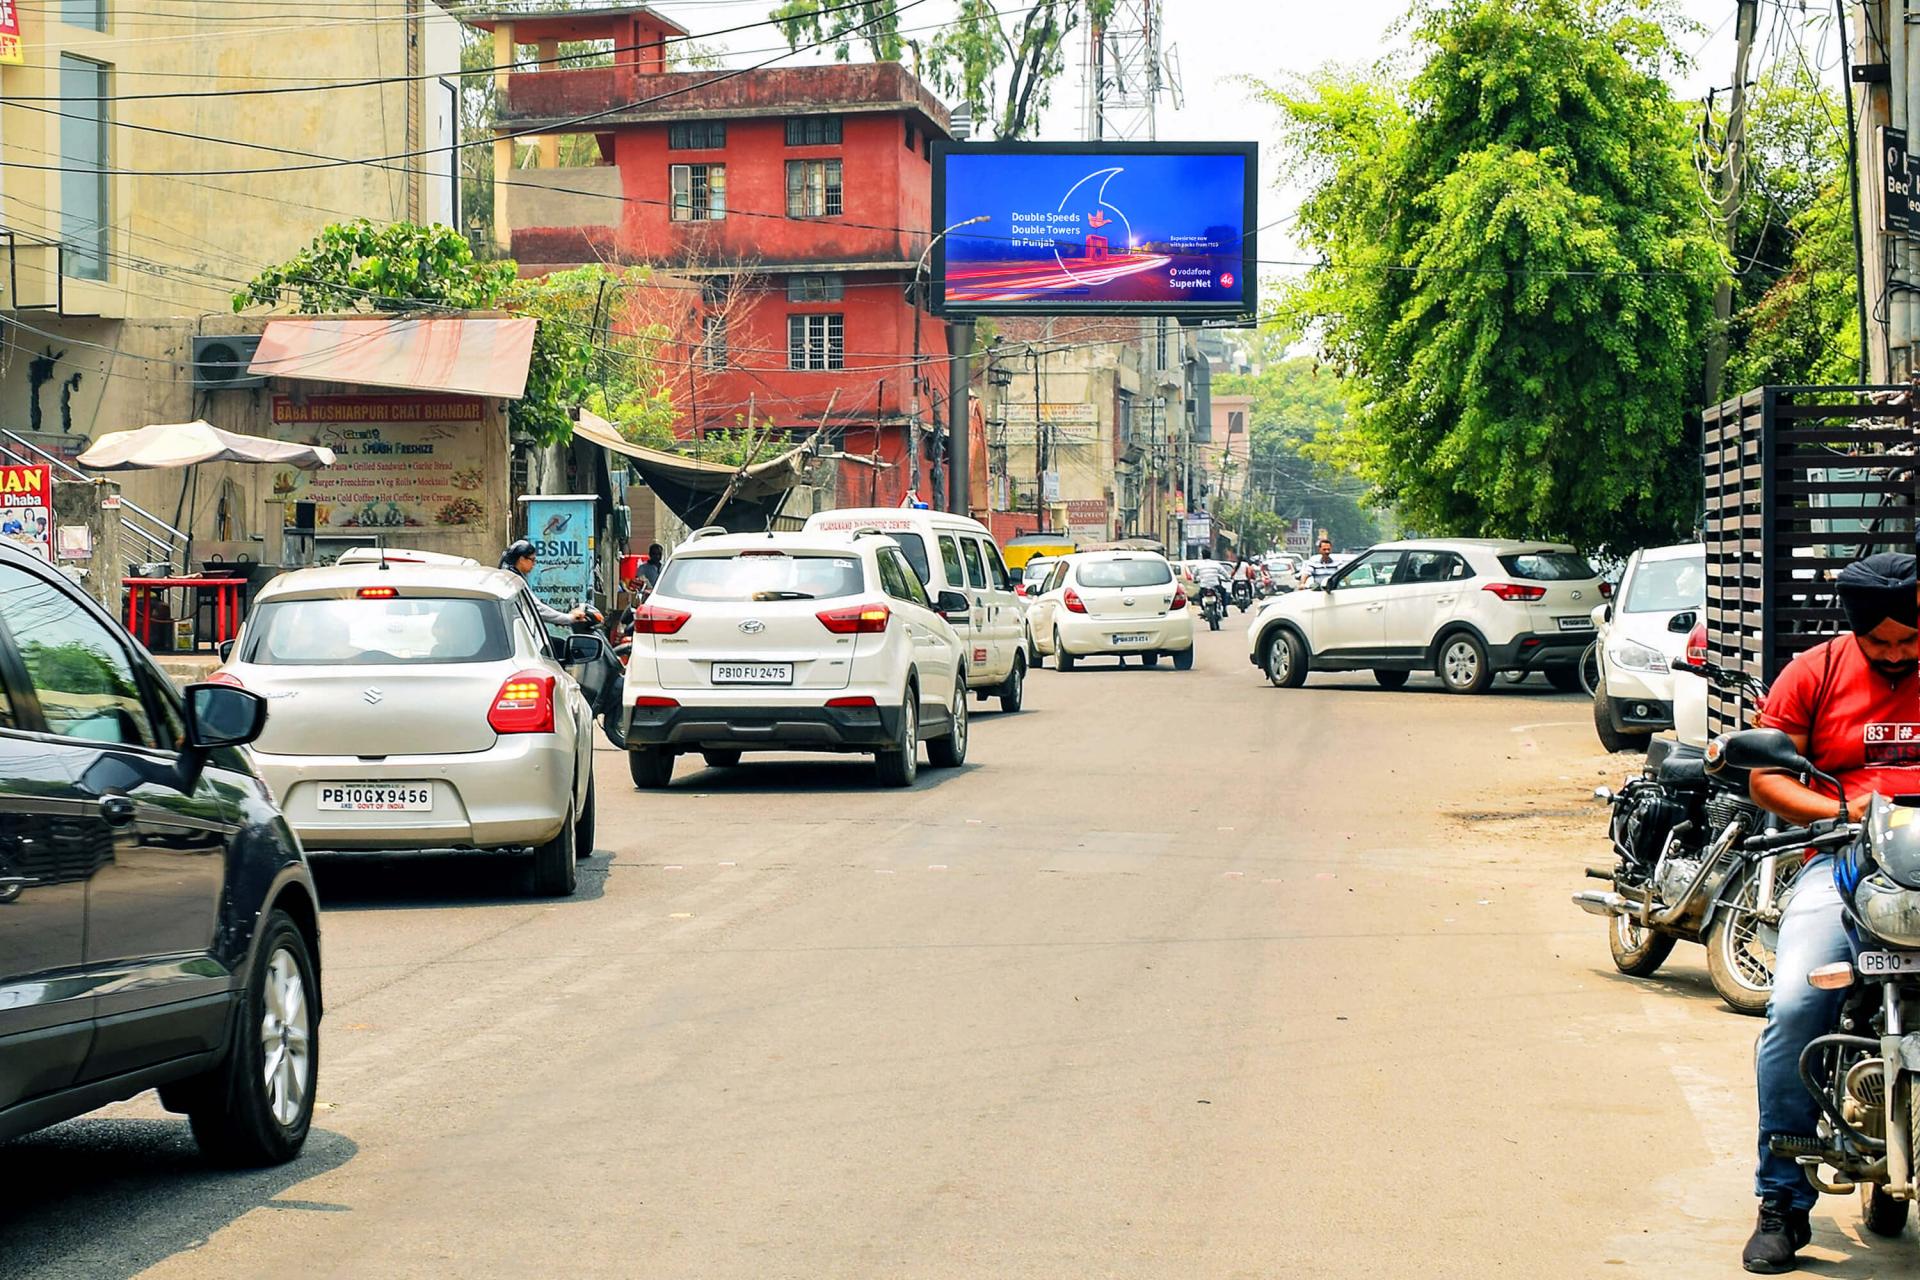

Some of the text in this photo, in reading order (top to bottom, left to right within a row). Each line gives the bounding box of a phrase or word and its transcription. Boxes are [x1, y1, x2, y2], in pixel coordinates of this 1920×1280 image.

[1012, 212, 1081, 224] Double Speeds
[1012, 225, 1081, 235] Double Towers
[1012, 237, 1055, 249] in Punjab
[1177, 267, 1212, 276] vodafone
[1169, 275, 1233, 290] SuperNet 4G
[276, 403, 480, 421] BABA HOSHIARPURI CHAT BHANDAR
[353, 462, 376, 471] Grilled
[376, 462, 407, 471] Sandwich
[313, 478, 336, 488] Burger
[379, 478, 394, 488] Veg
[394, 478, 412, 487] Rolls
[416, 478, 449, 487] Mocktails
[4, 492, 41, 507] Dhaba
[336, 493, 352, 503] Cold
[352, 493, 375, 503] Coffee
[379, 493, 393, 503] Hot
[393, 493, 415, 503] Coffee
[888, 519, 911, 530] CENTRE
[1287, 535, 1309, 545] SHIV
[535, 541, 583, 557] BSNL
[718, 667, 786, 679] PB10 FU 2475
[322, 789, 428, 803] PB10GX9456
[1866, 954, 1901, 970] PB10
